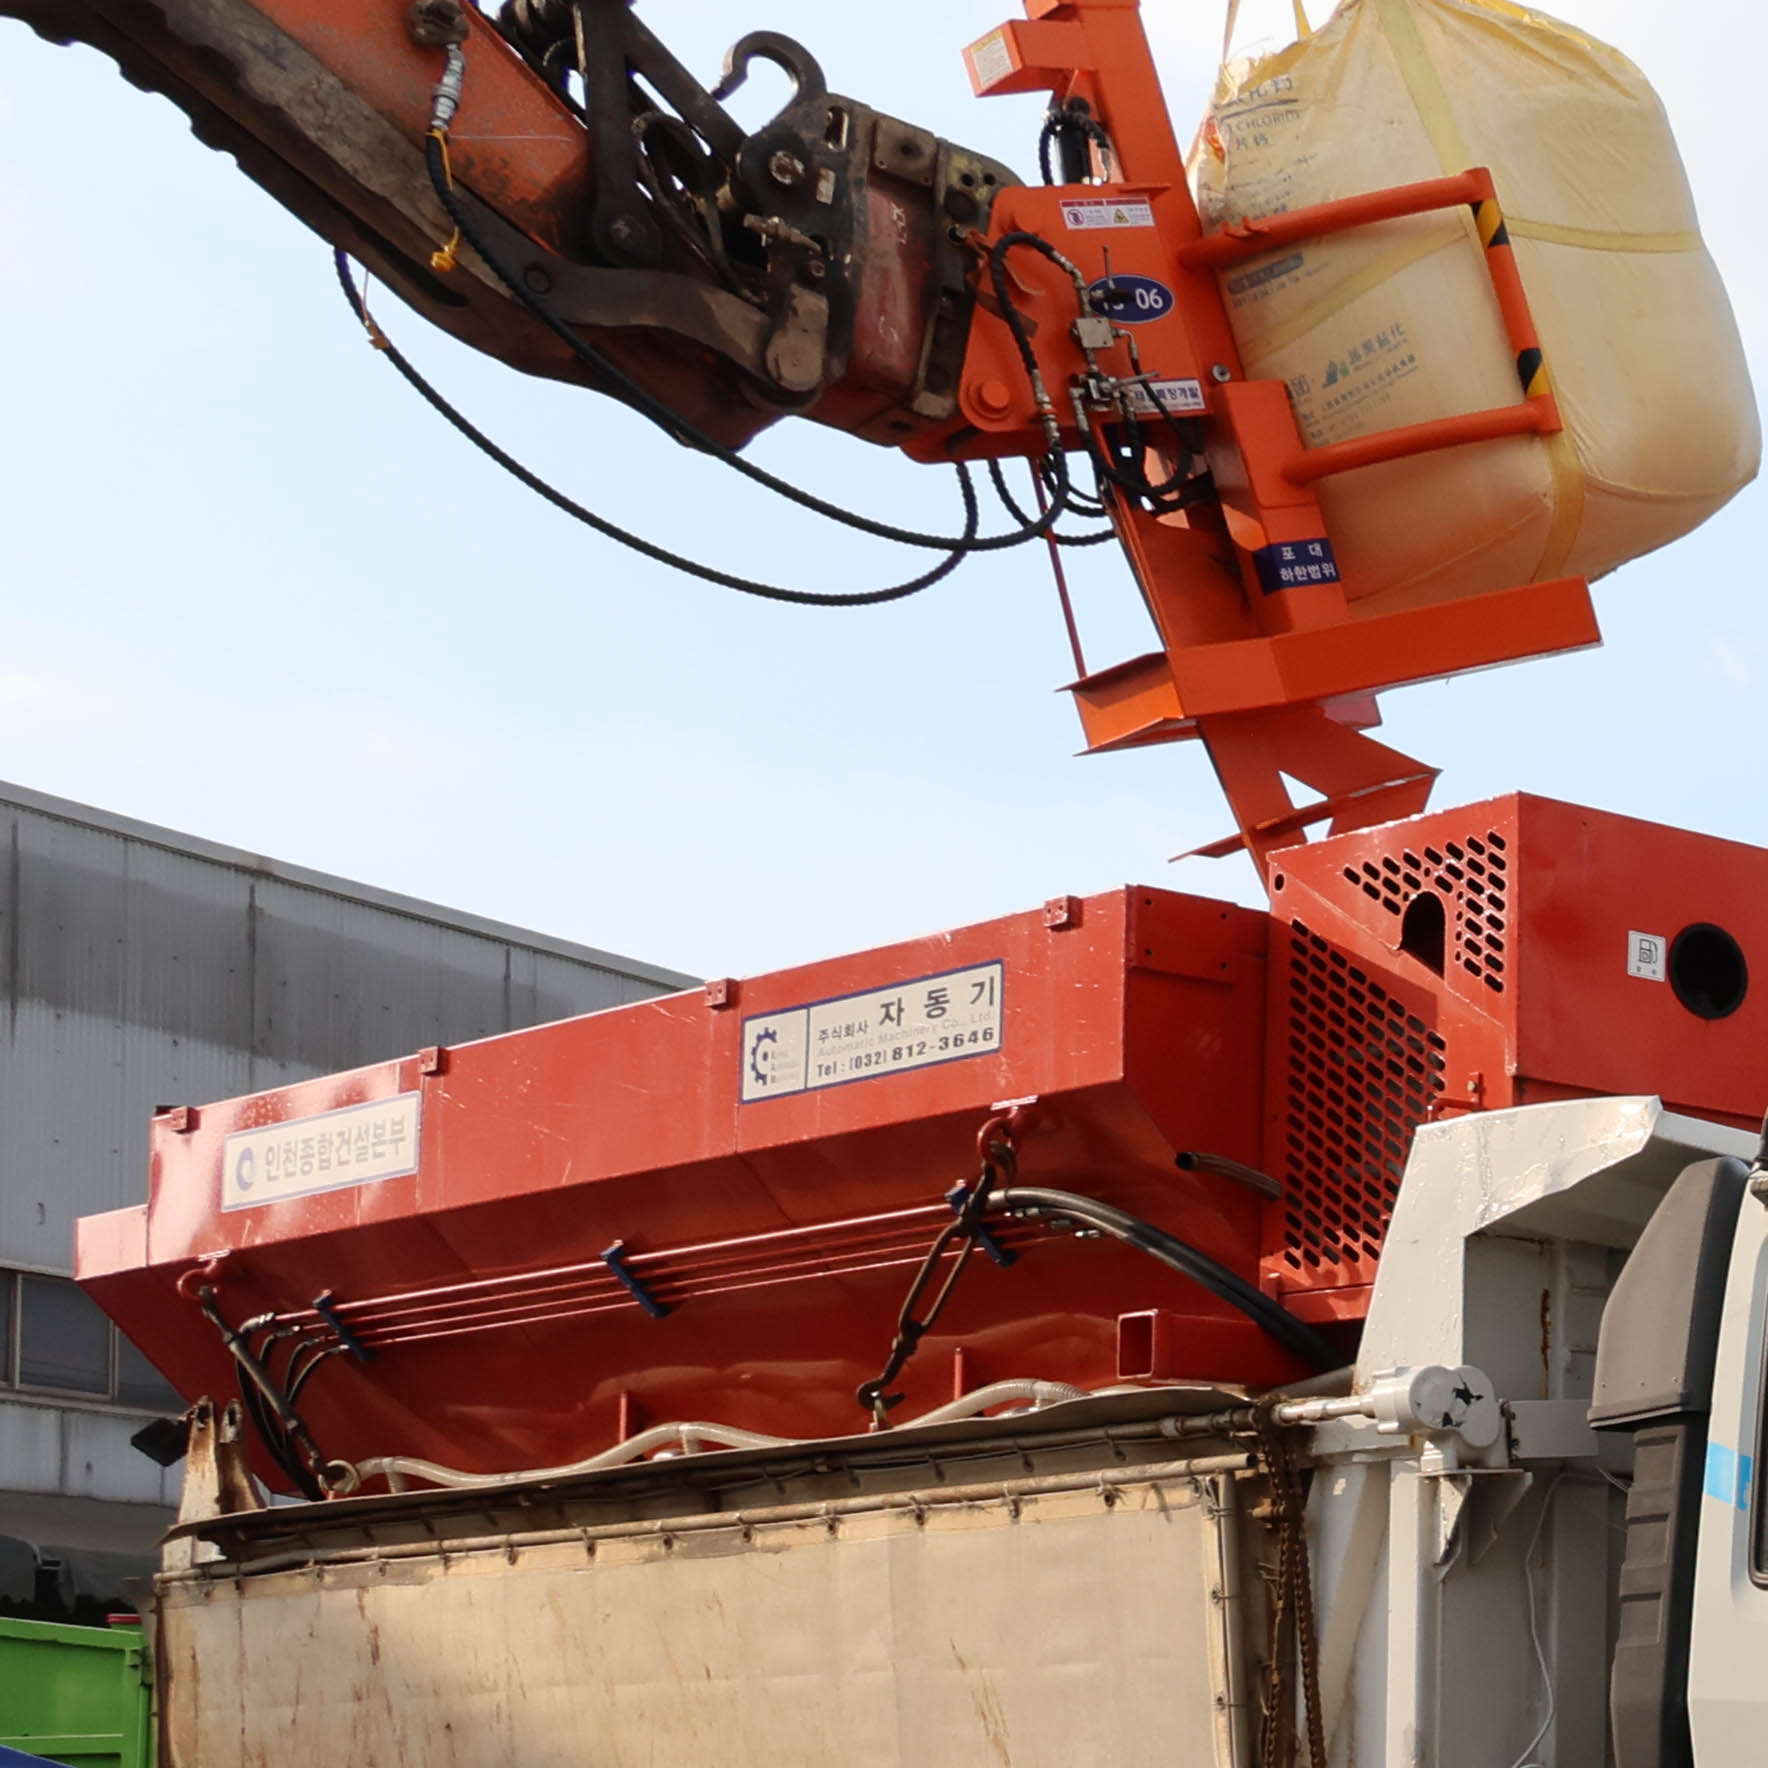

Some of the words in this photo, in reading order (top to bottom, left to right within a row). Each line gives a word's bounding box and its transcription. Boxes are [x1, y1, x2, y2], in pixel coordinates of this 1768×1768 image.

[1280, 562, 1336, 582] 하한범위
[817, 1020, 869, 1043] 주식회사
[892, 1027, 995, 1061] 812-3646
[265, 1114, 406, 1182] 인천종합건설본부
